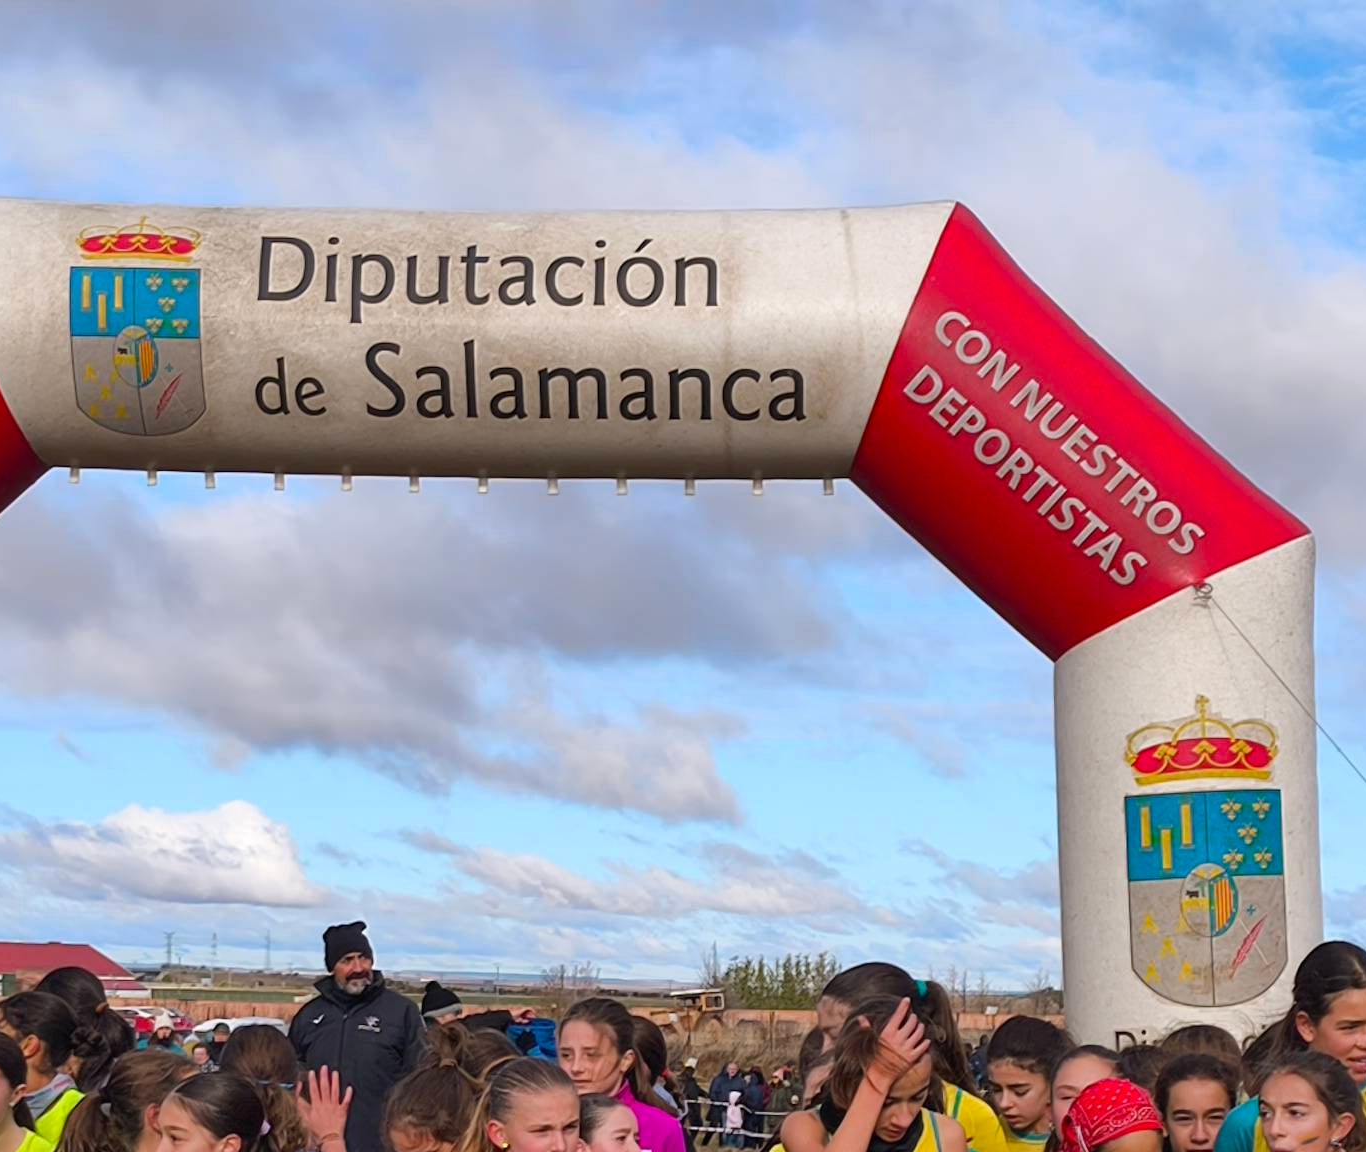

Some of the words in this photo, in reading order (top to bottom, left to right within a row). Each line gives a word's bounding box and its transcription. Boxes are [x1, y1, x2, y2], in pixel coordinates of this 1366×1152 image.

[256, 236, 719, 324] Diputación
[254, 356, 327, 417] de
[364, 338, 808, 422] Salamanca
[934, 311, 1021, 392] CON
[1009, 378, 1206, 555] NUESTROS
[902, 364, 1149, 587] DEPORTISTAS
